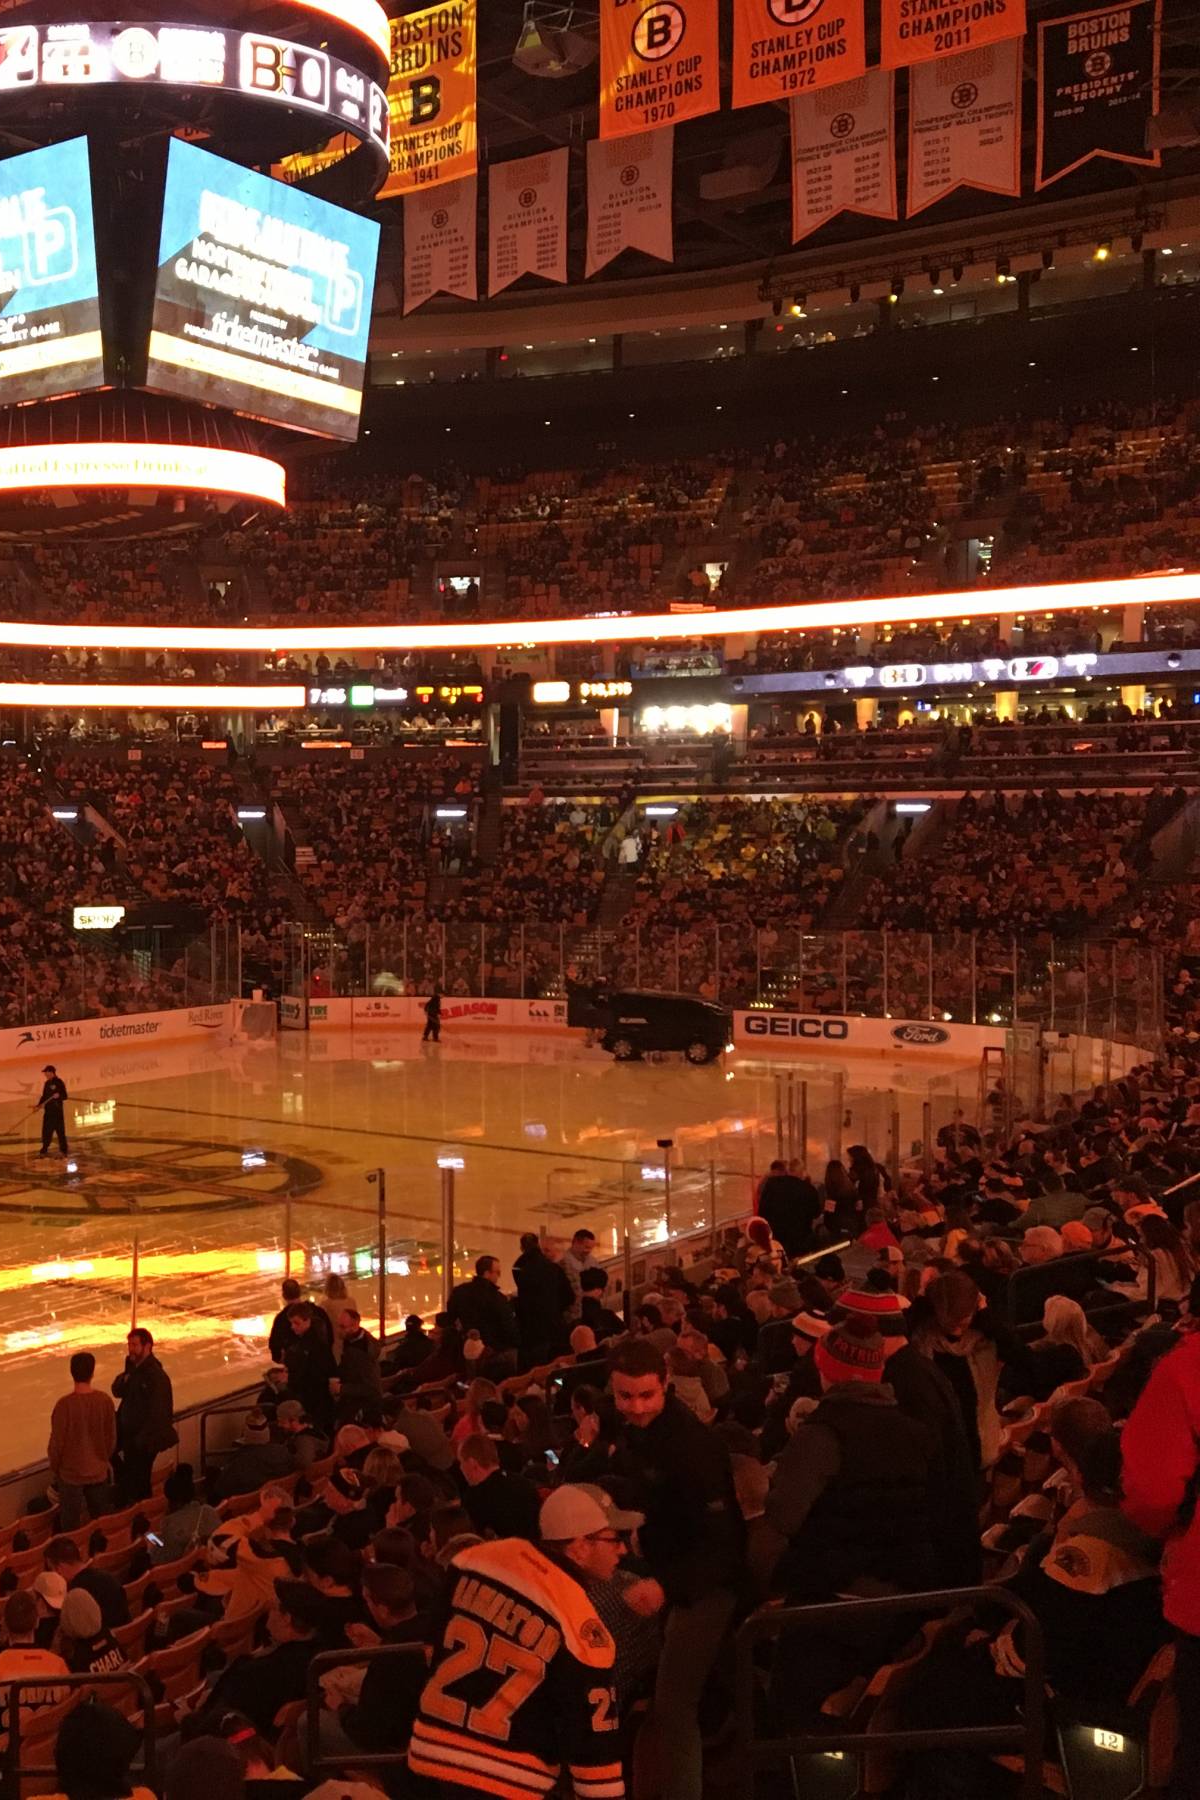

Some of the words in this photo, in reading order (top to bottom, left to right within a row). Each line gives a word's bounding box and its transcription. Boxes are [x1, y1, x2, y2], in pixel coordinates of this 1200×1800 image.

[390, 8, 463, 48] BOSTON
[899, 1, 1006, 39] CHAMPIONS
[1068, 11, 1131, 38] BOSTON
[750, 29, 814, 59] STANLEY
[818, 18, 845, 41] CUP
[934, 27, 971, 51] 2011
[1067, 28, 1130, 55] BRUINS
[390, 31, 462, 76] BRUINS
[750, 39, 846, 79] CHAMPIONS
[302, 57, 321, 97] 0
[616, 64, 672, 92] STANLEY
[676, 55, 702, 76] CUP
[781, 69, 816, 91] 1972
[1056, 70, 1139, 96] PRESIDENTS'
[410, 75, 441, 126] B
[615, 75, 702, 112] CHAMPIONS
[1072, 85, 1122, 102] TROPHY
[643, 102, 676, 124] 1970
[913, 123, 940, 134] PRINCE
[956, 115, 981, 127] WALES
[984, 109, 1014, 123] TROPHY
[914, 111, 965, 127] CONFERENCE
[966, 102, 1013, 116] CHAMPIONS
[390, 127, 438, 155] STANLEY
[441, 122, 462, 142] CUP
[797, 139, 844, 155] CONFERENCE
[844, 128, 887, 146] CHAMPIONS
[861, 136, 887, 148] TROPHY
[390, 140, 462, 173] CHAMPIONS
[414, 165, 439, 185] 1941
[602, 193, 657, 209] CHAMPIONS
[609, 186, 651, 200] DIVISION
[502, 215, 554, 231] CHAMPIONS
[507, 207, 547, 220] DIVISION
[35, 219, 64, 274] P
[416, 236, 465, 251] CHAMPIONS
[421, 228, 458, 242] DIVISION
[211, 311, 313, 362] ticketmaster
[52, 458, 129, 474] Espresso
[133, 458, 183, 474] Drinks
[188, 1010, 202, 1024] Red
[204, 1009, 224, 1021] River
[744, 1016, 848, 1039] GEICO
[36, 1026, 82, 1042] SYMETRA
[100, 1021, 160, 1040] ticketmaster
[902, 1024, 940, 1043] Ford
[452, 1575, 561, 1664] HAMILTON
[420, 1614, 546, 1740] 27
[1100, 1732, 1118, 1748] 12
